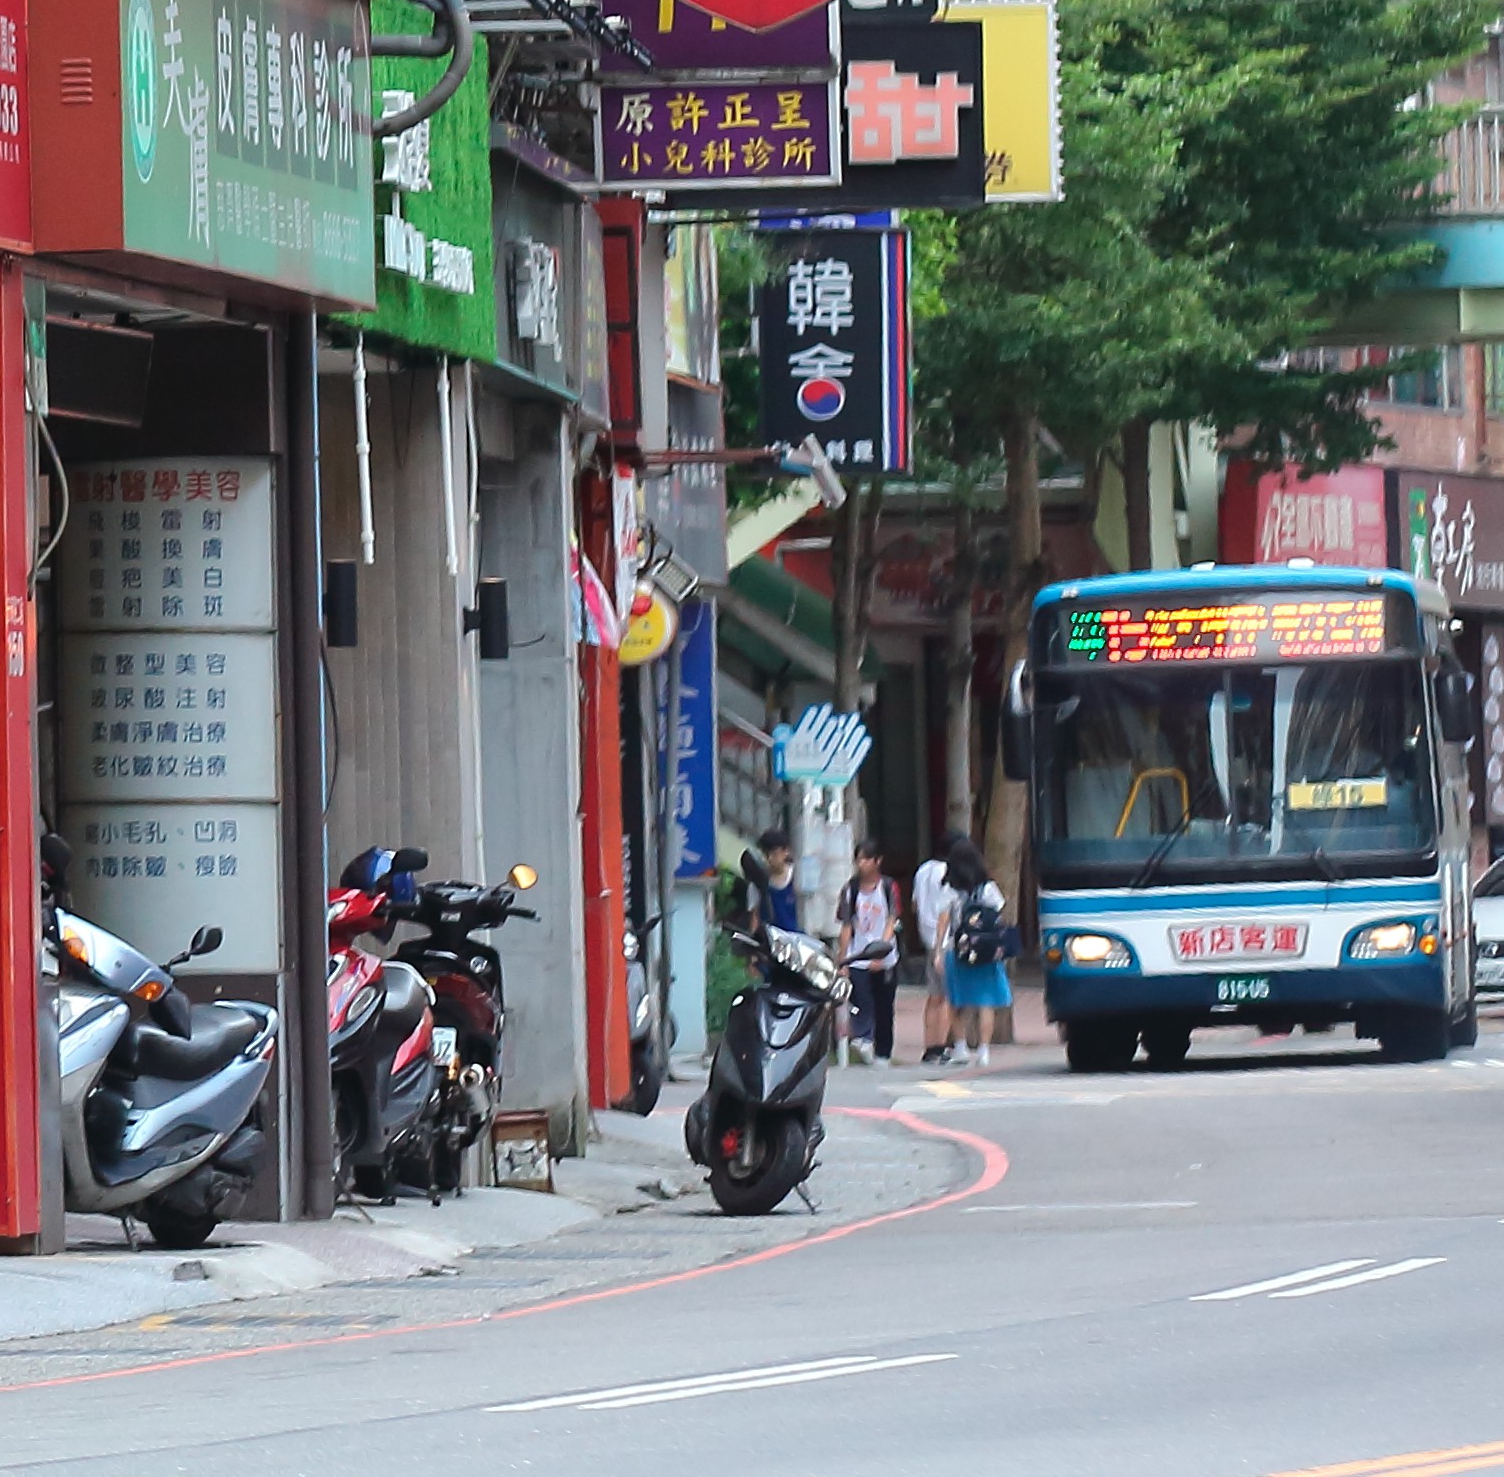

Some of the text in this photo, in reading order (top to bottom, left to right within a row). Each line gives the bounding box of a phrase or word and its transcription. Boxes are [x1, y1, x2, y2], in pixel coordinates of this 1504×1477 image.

[618, 136, 816, 174] 小兒科診所
[1179, 926, 1298, 956] 新店客運
